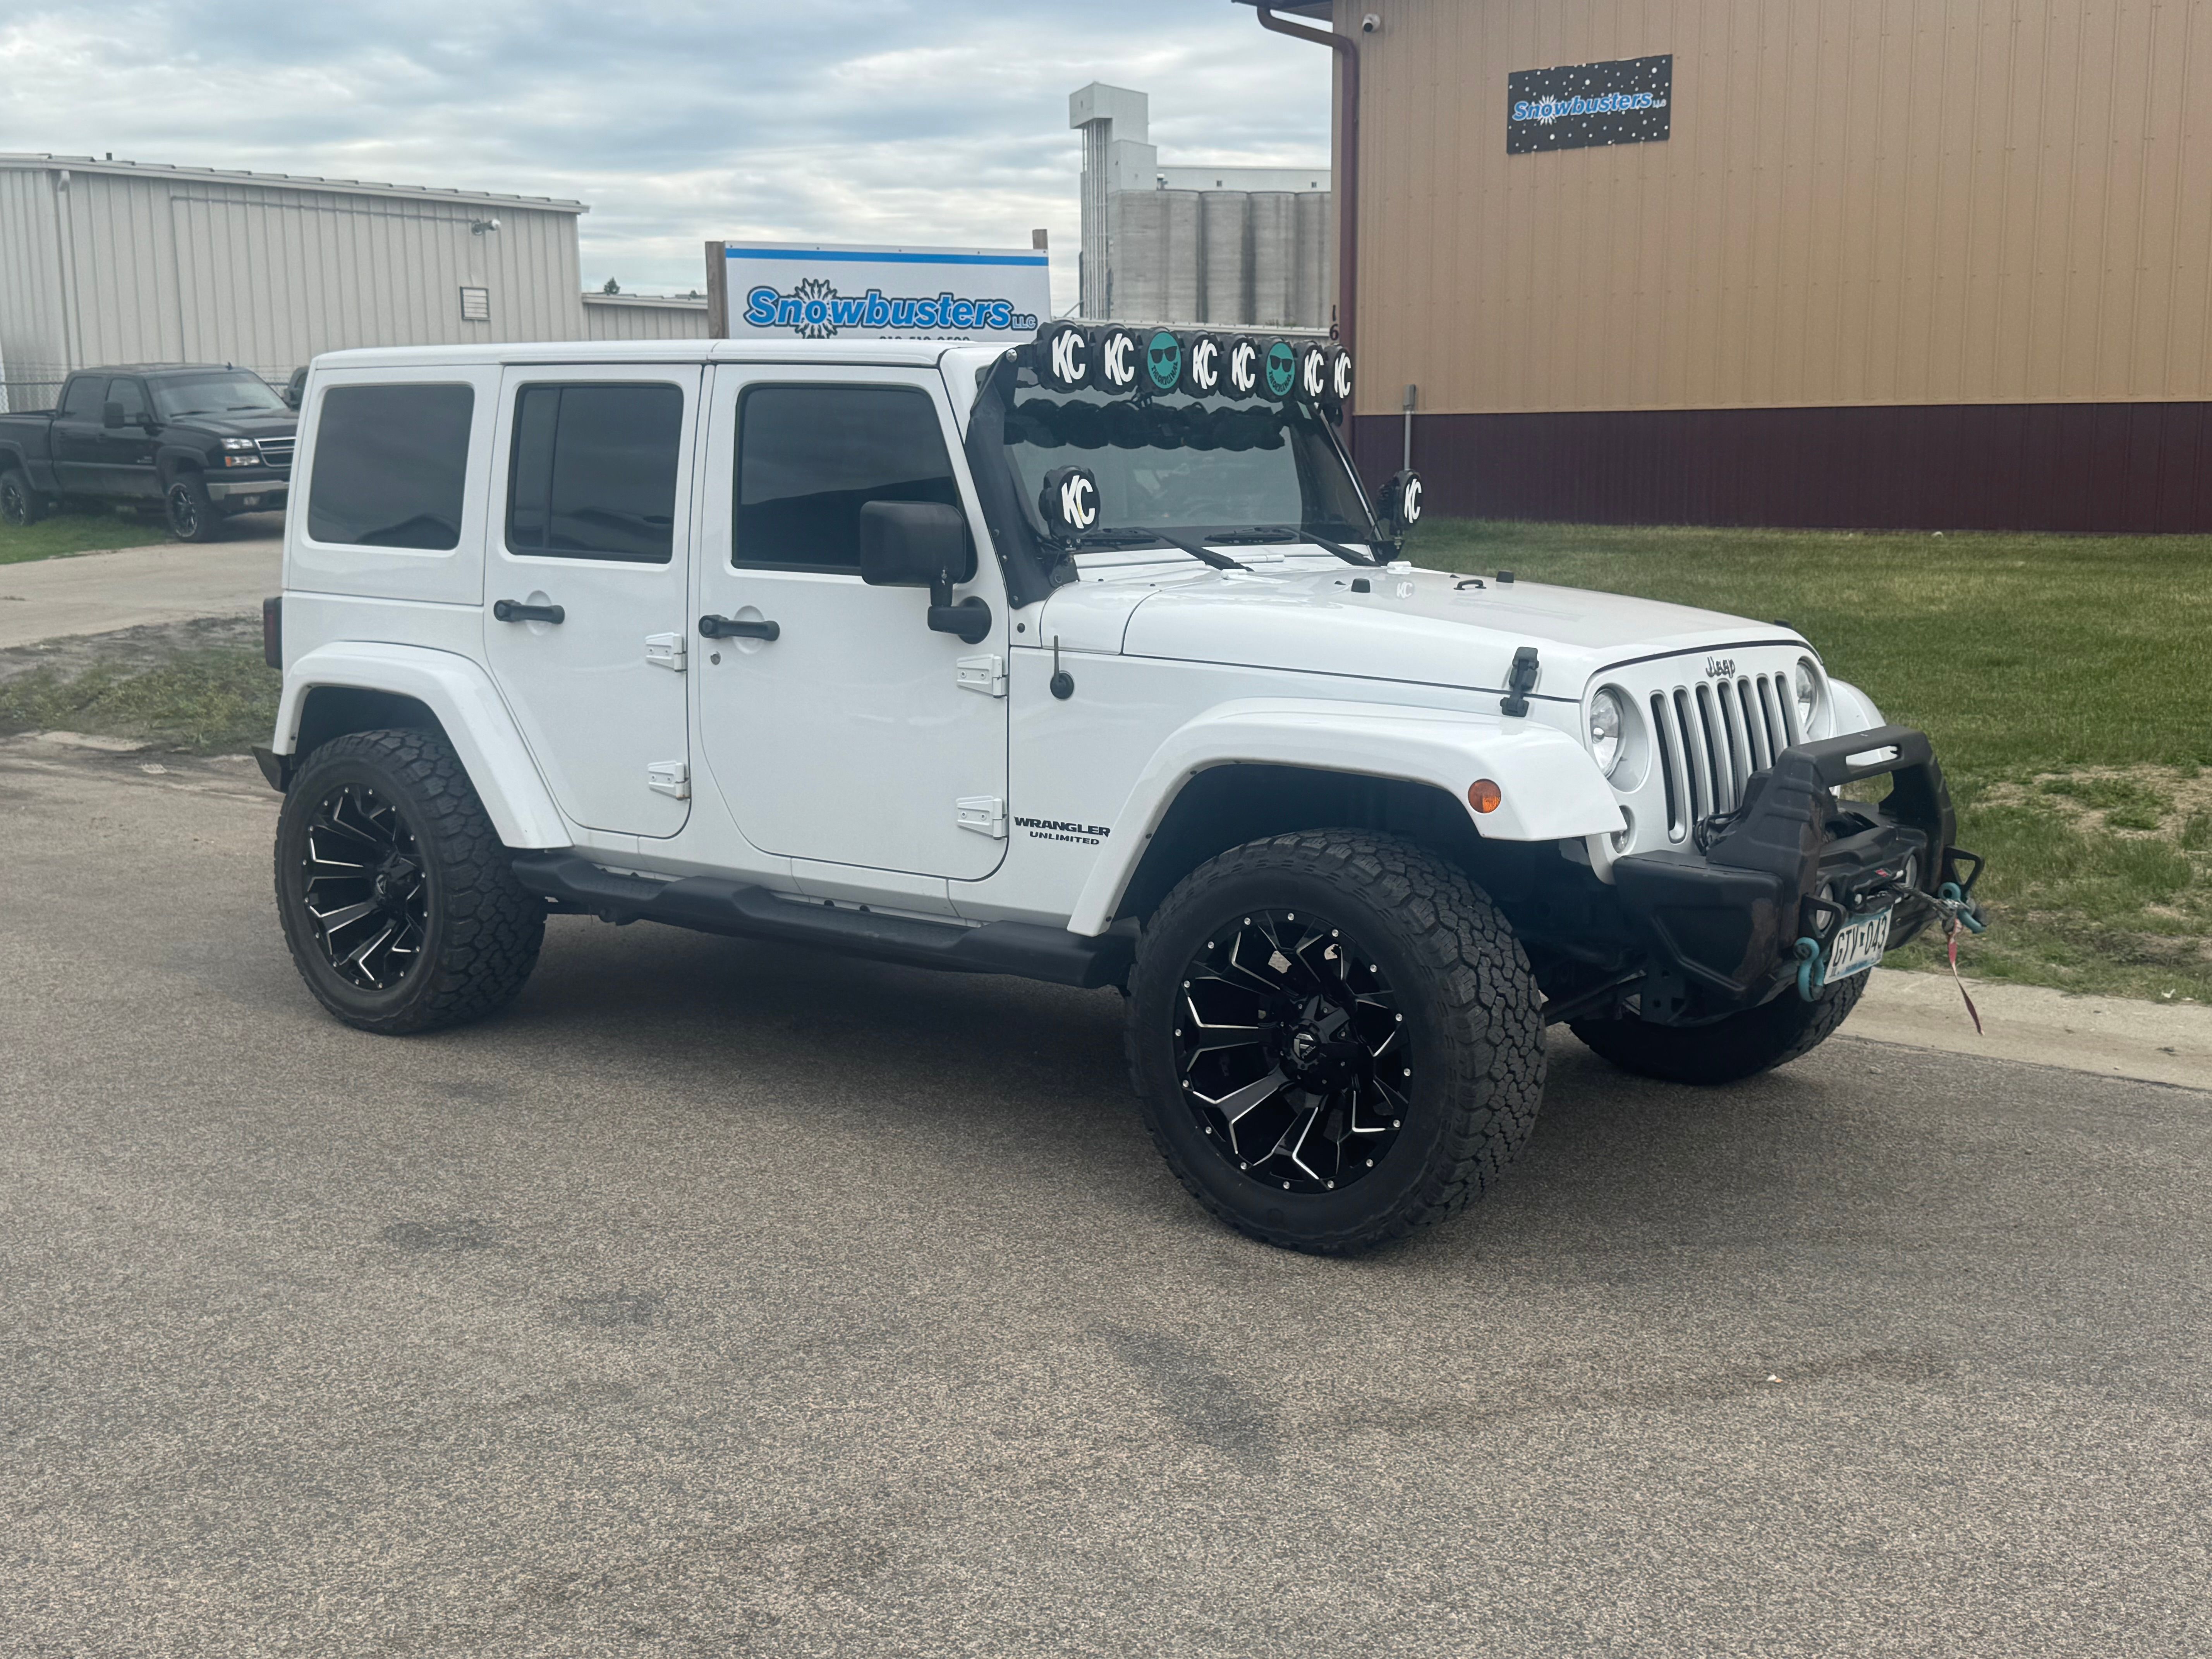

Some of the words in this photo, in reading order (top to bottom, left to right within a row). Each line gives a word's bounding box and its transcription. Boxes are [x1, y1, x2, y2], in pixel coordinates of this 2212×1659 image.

[1512, 92, 1653, 121] Snowbusters
[744, 286, 1014, 330] Snowbusters
[1012, 315, 1036, 329] LLC
[1052, 330, 1085, 383] KC
[1105, 333, 1135, 386] KC
[1193, 339, 1218, 389] KC
[1232, 342, 1255, 392] KC
[1304, 350, 1324, 397] KC
[1334, 352, 1351, 398] KC
[1061, 475, 1095, 529] KC
[1404, 479, 1422, 523] KC
[1705, 656, 1735, 678] Jeep
[1014, 816, 1111, 838] WRANGLER
[1030, 831, 1099, 845] UNLIMITED
[1865, 915, 1887, 955] 043
